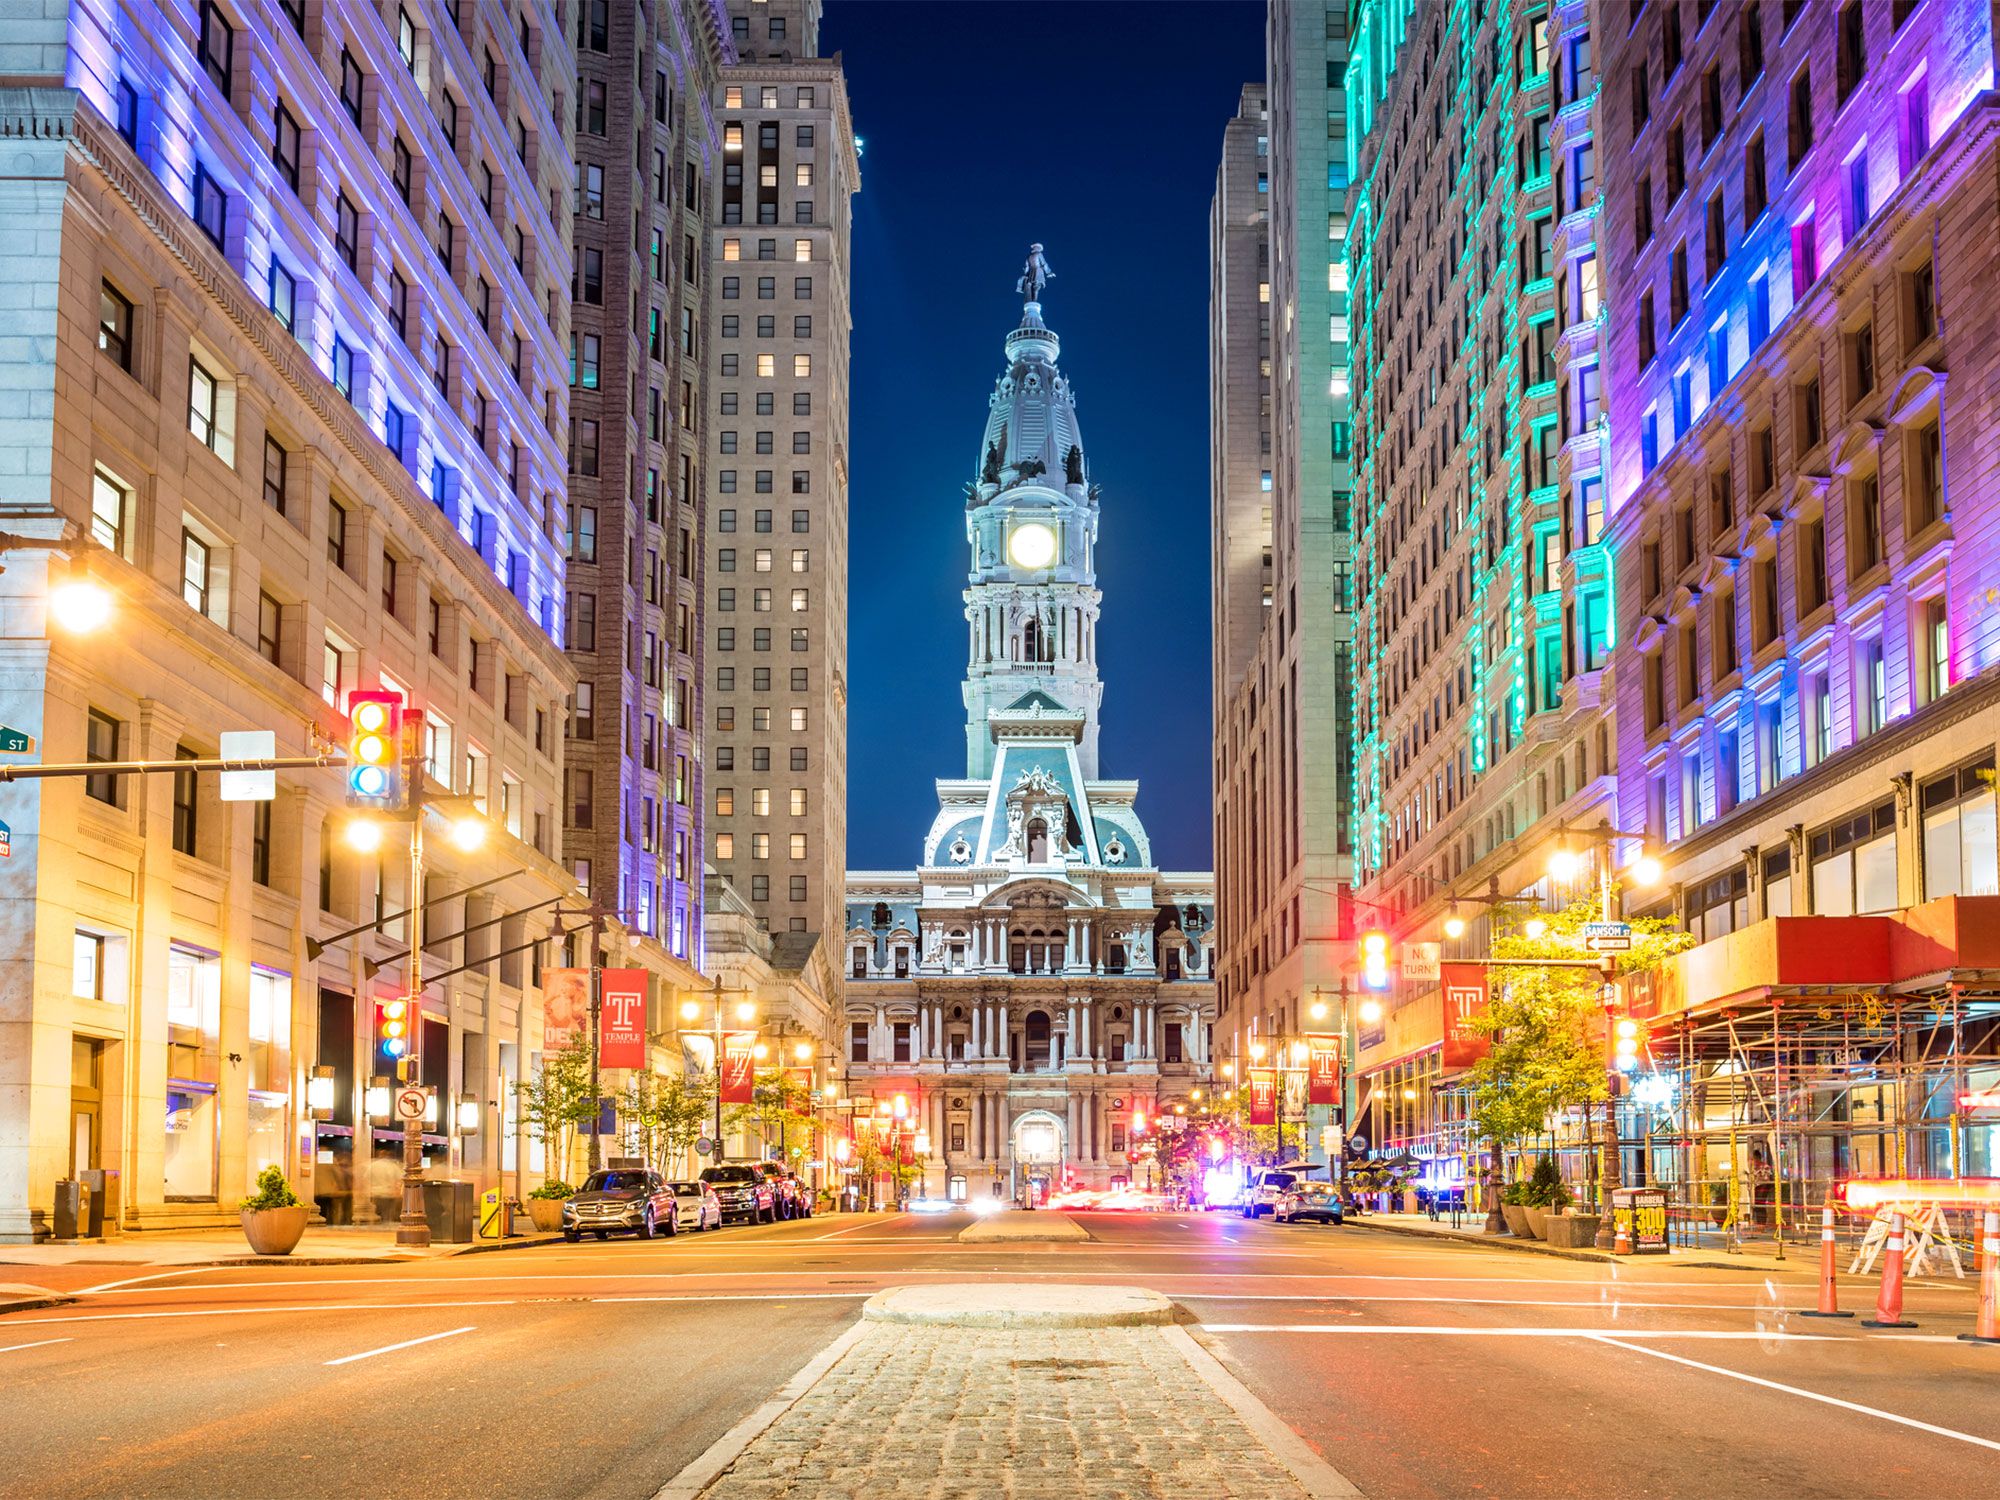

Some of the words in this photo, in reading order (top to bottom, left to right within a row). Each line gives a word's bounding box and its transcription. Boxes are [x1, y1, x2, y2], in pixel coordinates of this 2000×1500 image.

[9, 740, 24, 750] ST
[1586, 926, 1621, 936] SANSOM
[1405, 964, 1437, 974] TURNS
[605, 1033, 640, 1041] TEMPLE
[1835, 1047, 1862, 1064] Bank
[1635, 1207, 1665, 1229] 300
